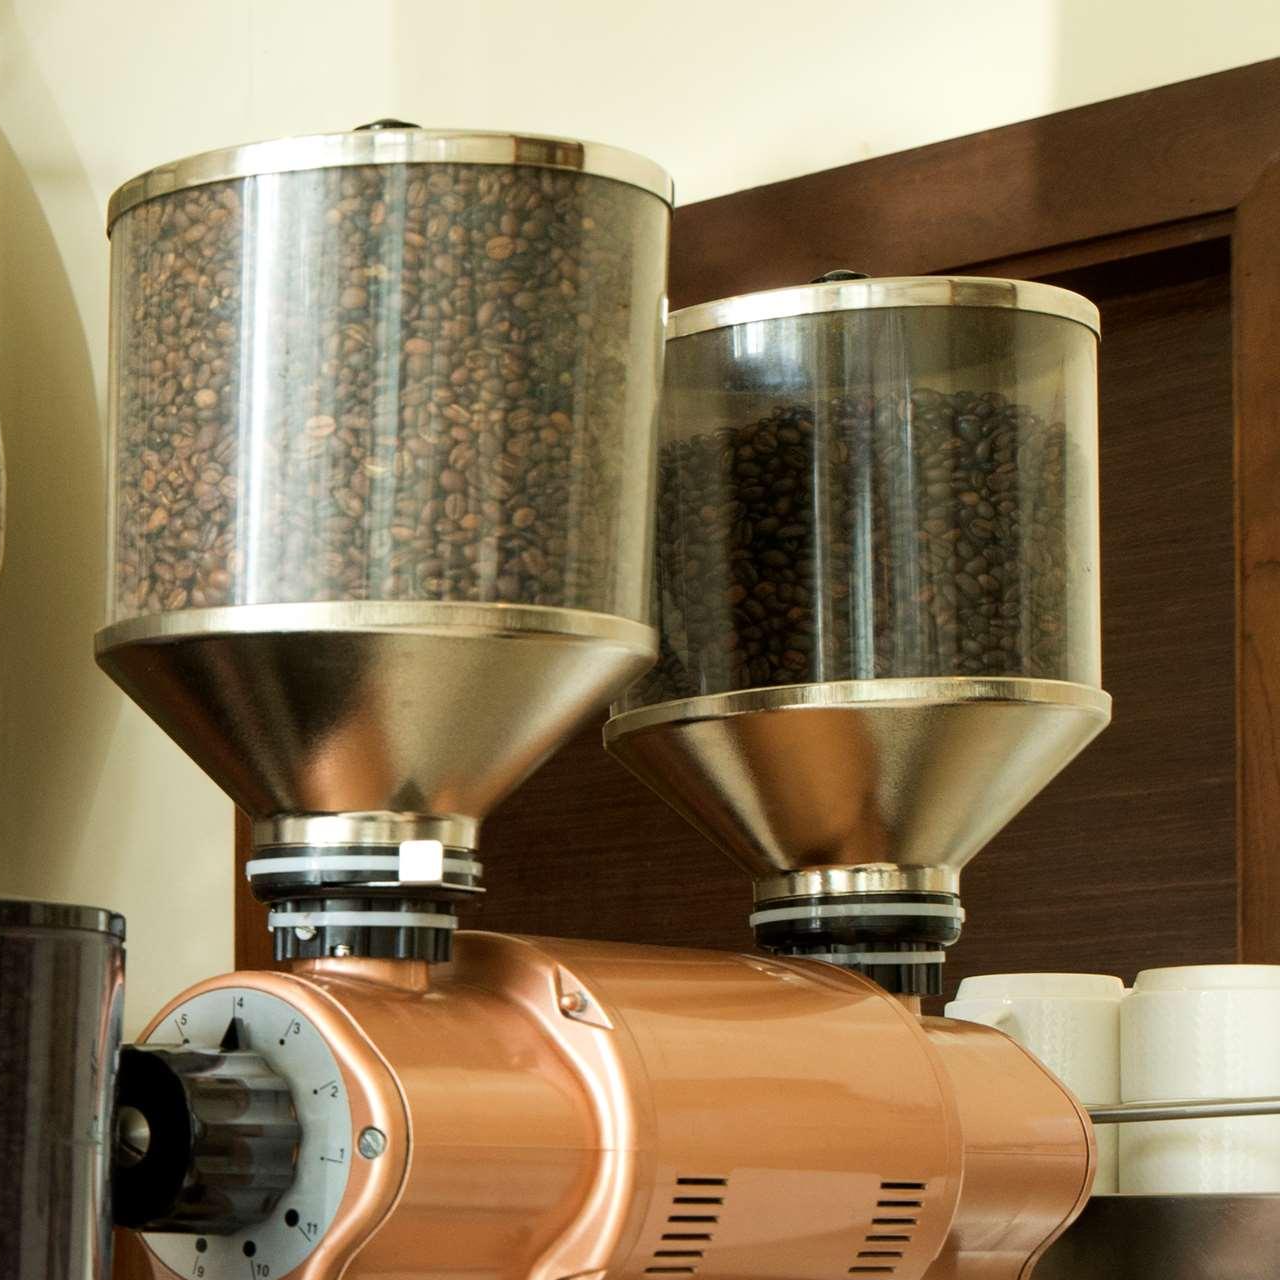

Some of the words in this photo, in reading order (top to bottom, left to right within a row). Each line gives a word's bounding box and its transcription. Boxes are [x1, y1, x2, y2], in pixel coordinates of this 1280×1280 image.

[236, 997, 244, 1008] 4
[180, 1013, 188, 1026] 5
[293, 1022, 302, 1035] 3
[330, 1086, 339, 1098] 2
[306, 1222, 318, 1235] 11
[197, 1265, 205, 1278] 9
[256, 1264, 270, 1278] 10
